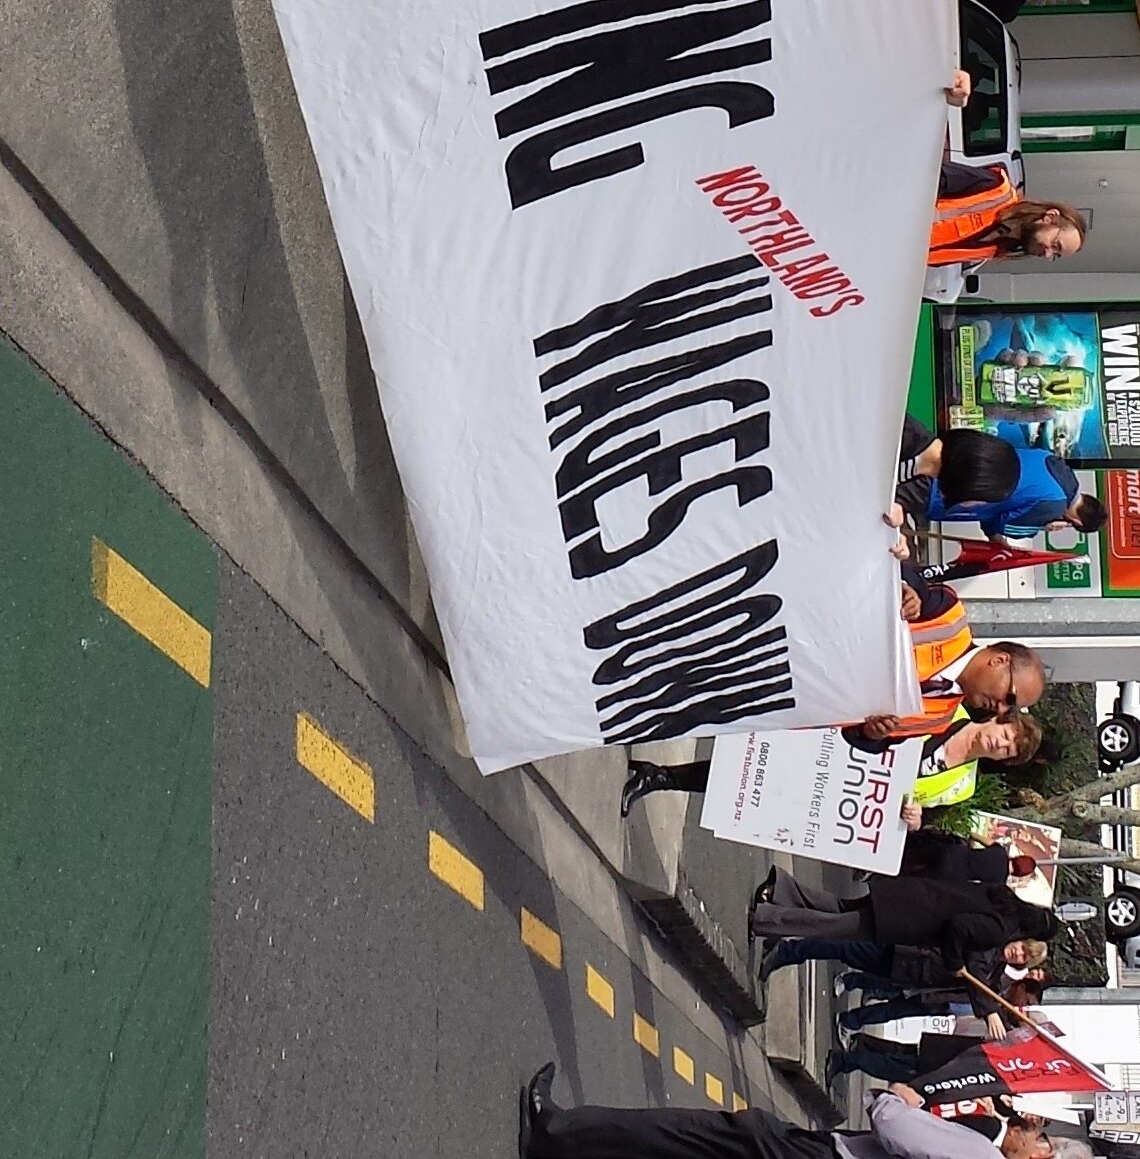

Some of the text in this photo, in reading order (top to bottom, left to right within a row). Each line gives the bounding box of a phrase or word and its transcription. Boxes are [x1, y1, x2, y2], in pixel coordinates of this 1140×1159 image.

[696, 165, 864, 318] NORTHLAND'S
[1101, 324, 1140, 391] WIN
[532, 254, 774, 581] WAGES
[1116, 400, 1130, 446] EXPERIENCE
[1072, 562, 1084, 580] PG
[584, 537, 795, 745] DOWN
[734, 732, 756, 822] ww.firstunion.org.nz
[750, 741, 770, 808] 0800 863 477
[803, 727, 838, 848] Putting Workers First
